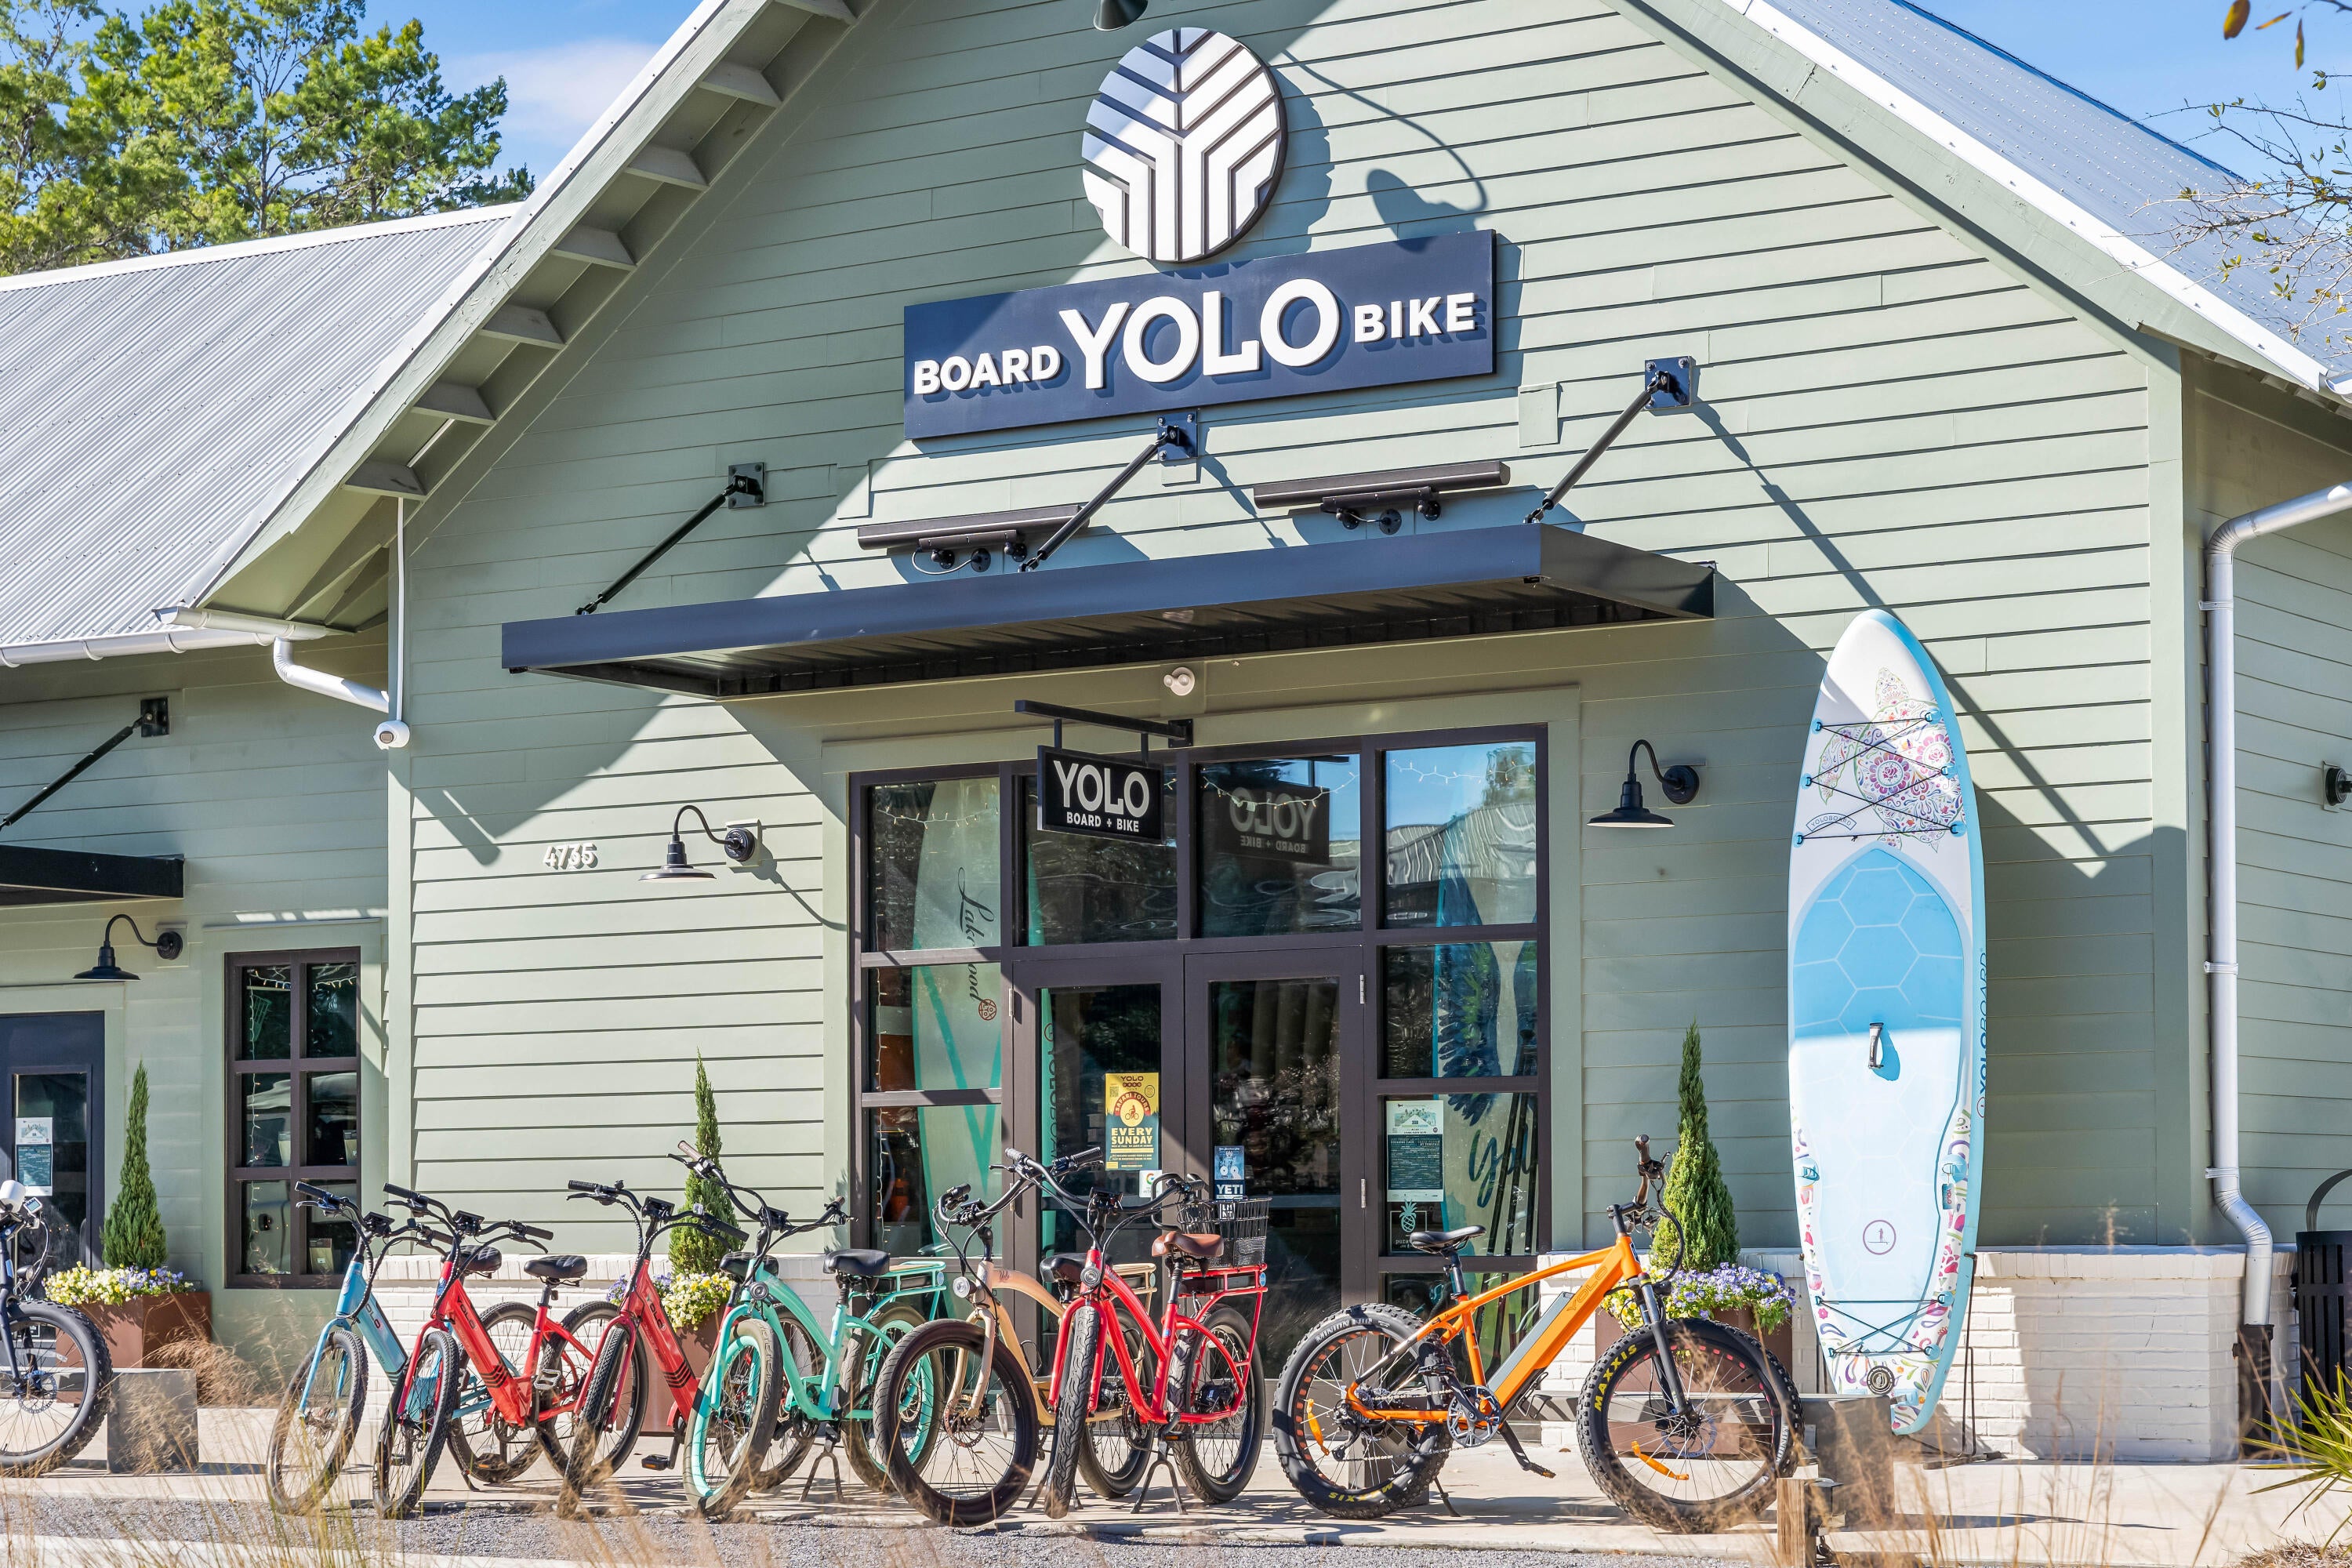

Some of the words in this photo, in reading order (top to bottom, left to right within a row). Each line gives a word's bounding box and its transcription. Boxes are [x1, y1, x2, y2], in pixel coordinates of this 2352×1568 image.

[913, 345, 1060, 395] BOARD
[1059, 278, 1339, 389] YOLO
[1354, 292, 1476, 343] BIKE
[1054, 760, 1149, 817] YOLO
[1067, 811, 1102, 827] BOARD
[1117, 818, 1139, 833] BIKE
[543, 843, 594, 867] 4735
[1111, 1127, 1153, 1136] EVERY
[1111, 1135, 1153, 1145] SUNDAY
[1216, 1184, 1243, 1194] YETI
[1566, 1266, 1607, 1312] YOLO
[365, 1303, 381, 1329] OLO
[1594, 1344, 1638, 1412] MAXXIS
